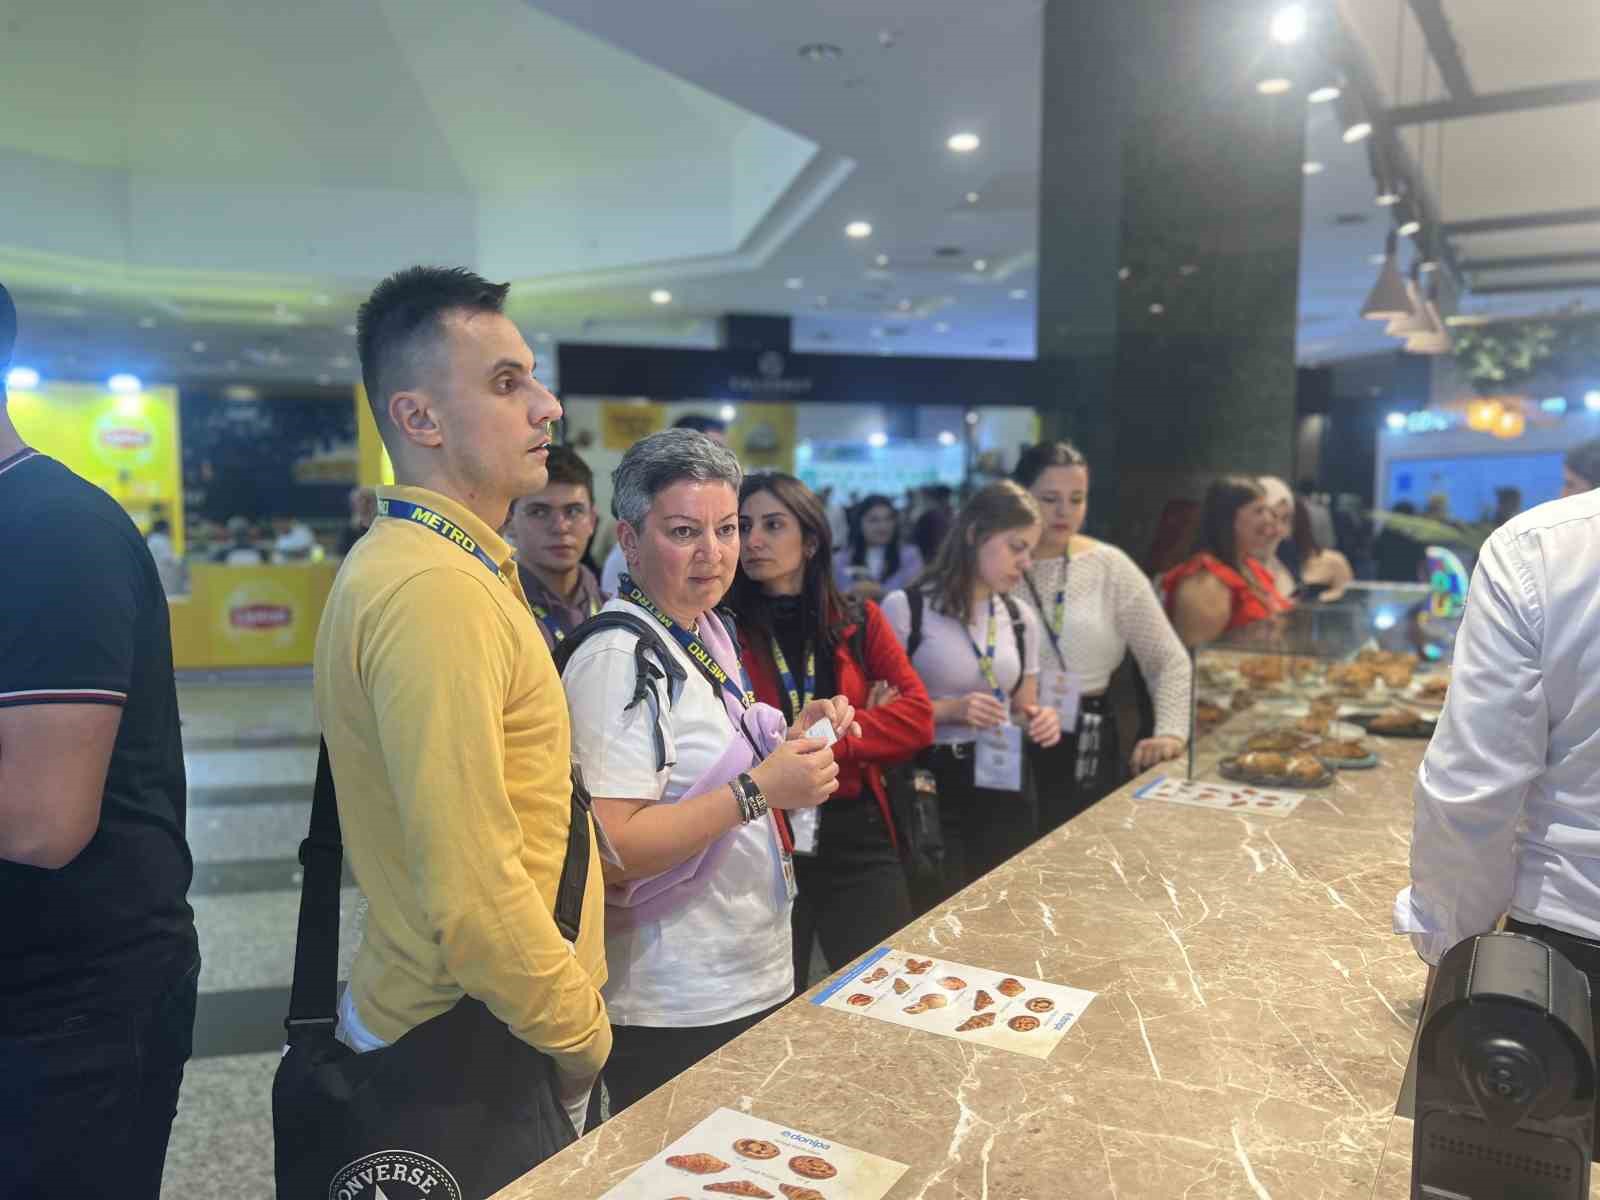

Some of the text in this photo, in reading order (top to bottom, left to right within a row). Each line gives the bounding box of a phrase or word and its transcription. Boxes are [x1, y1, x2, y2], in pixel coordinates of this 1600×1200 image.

[410, 506, 476, 552] METRO
[687, 642, 727, 684] METRO
[337, 1163, 439, 1200] ONVERSE
